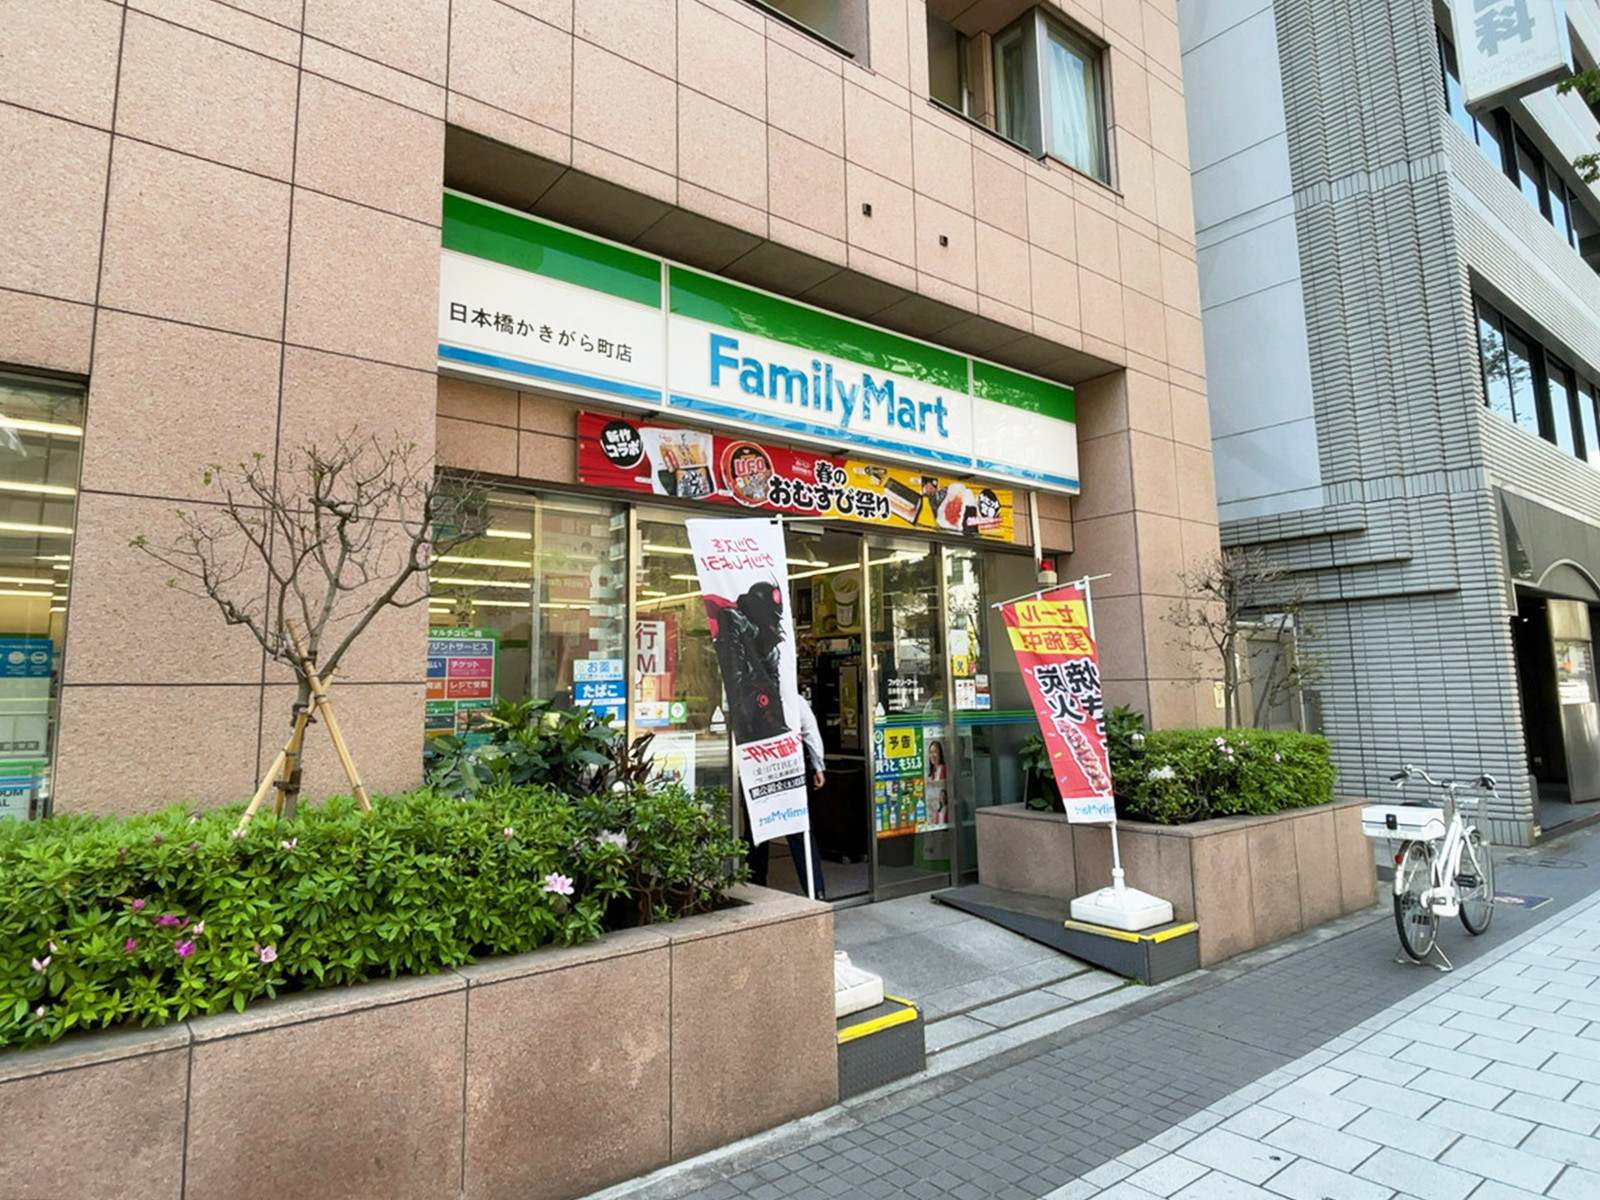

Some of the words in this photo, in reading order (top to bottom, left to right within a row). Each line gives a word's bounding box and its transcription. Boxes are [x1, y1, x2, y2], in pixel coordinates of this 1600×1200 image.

[1473, 0, 1536, 57] 科
[450, 302, 632, 363] 日本橋かきがら町店
[710, 333, 948, 438] FamilyMart
[606, 428, 632, 443] 新作
[606, 441, 640, 458] コラボ
[816, 462, 847, 484] 春の
[769, 475, 889, 518] おむすび祭り
[583, 684, 618, 698] たばこ
[889, 735, 911, 750] 予告
